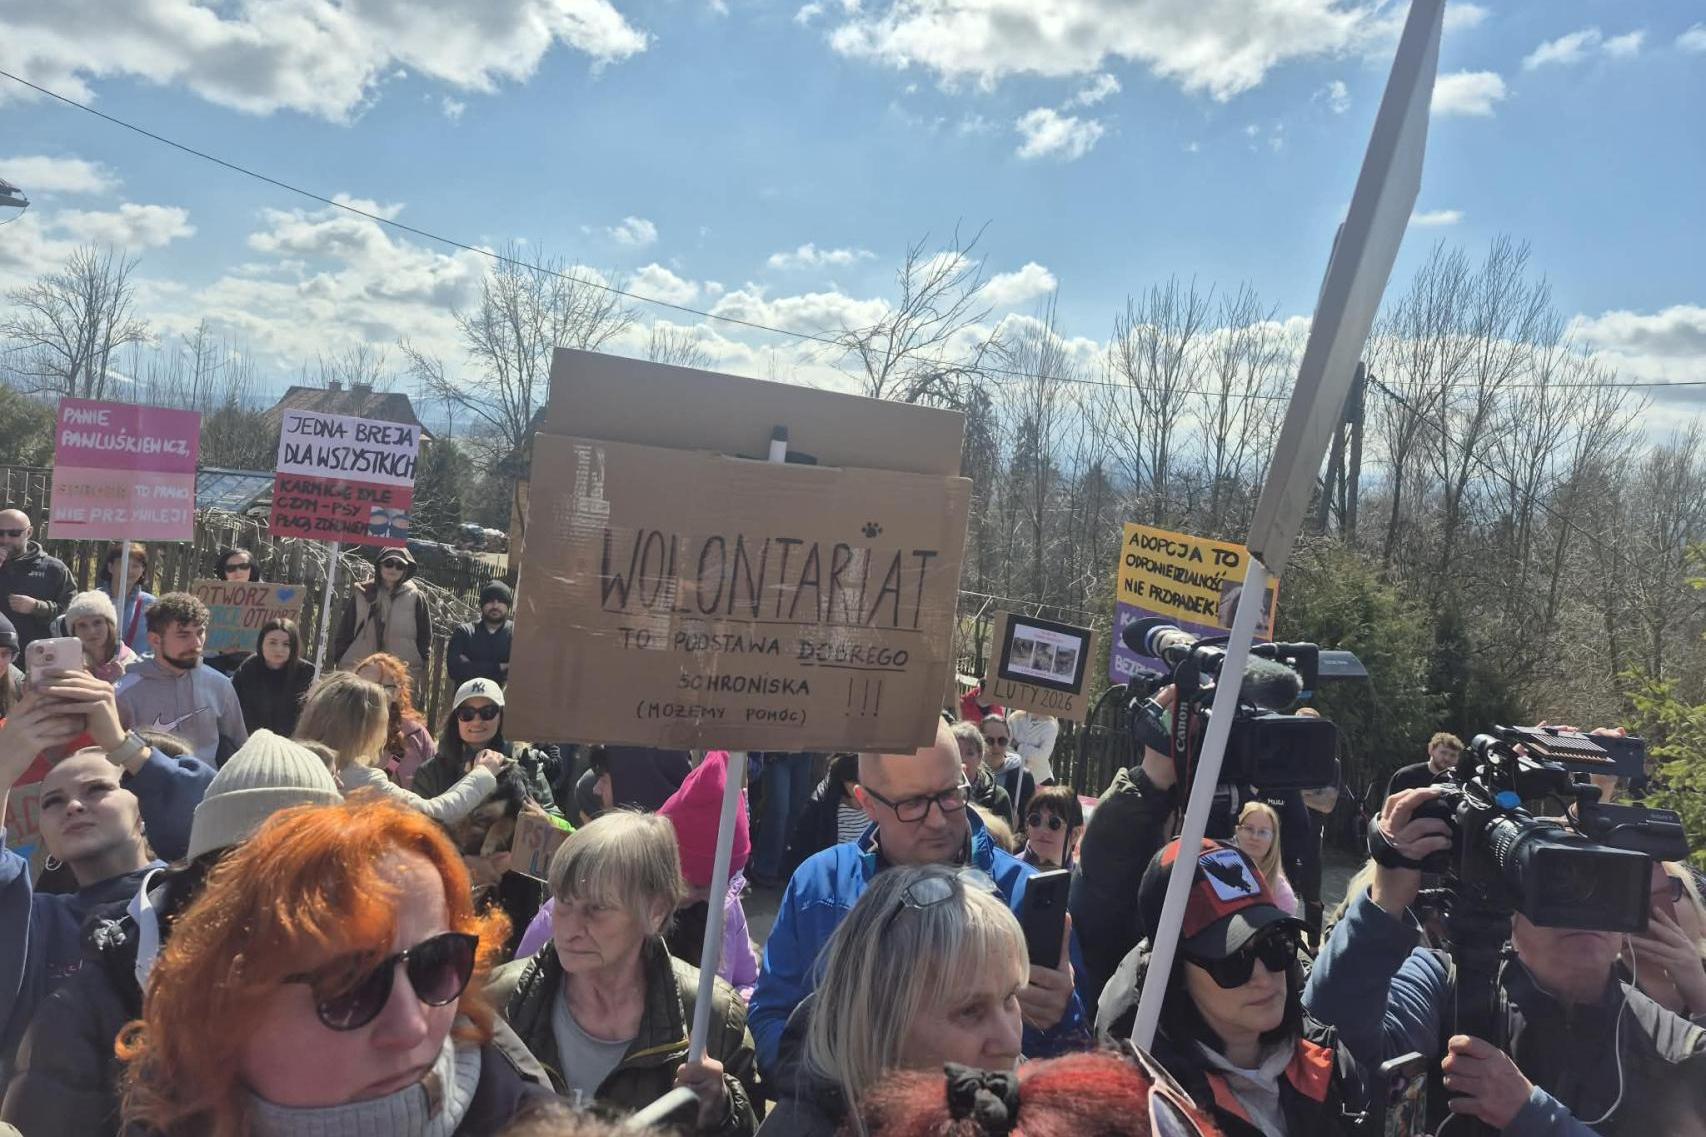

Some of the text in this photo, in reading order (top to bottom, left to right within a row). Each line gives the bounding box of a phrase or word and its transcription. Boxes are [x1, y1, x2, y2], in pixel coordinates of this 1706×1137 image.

[63, 407, 111, 426] PANIE
[288, 416, 413, 447] JEDNA BREJA
[284, 443, 418, 479] DLA WSZYSTKICH
[55, 507, 86, 521] NIE
[331, 501, 362, 516] PSY
[1129, 532, 1240, 568] ADOPCJA TO
[601, 528, 938, 628] WOLONTARIAT
[1124, 578, 1145, 596] NIE
[617, 627, 650, 649] TO
[674, 634, 780, 656] PODSTAWA
[679, 672, 882, 717] SCHRONISKA !!!
[993, 680, 1039, 703] LUTY
[1176, 702, 1188, 752] Canon
